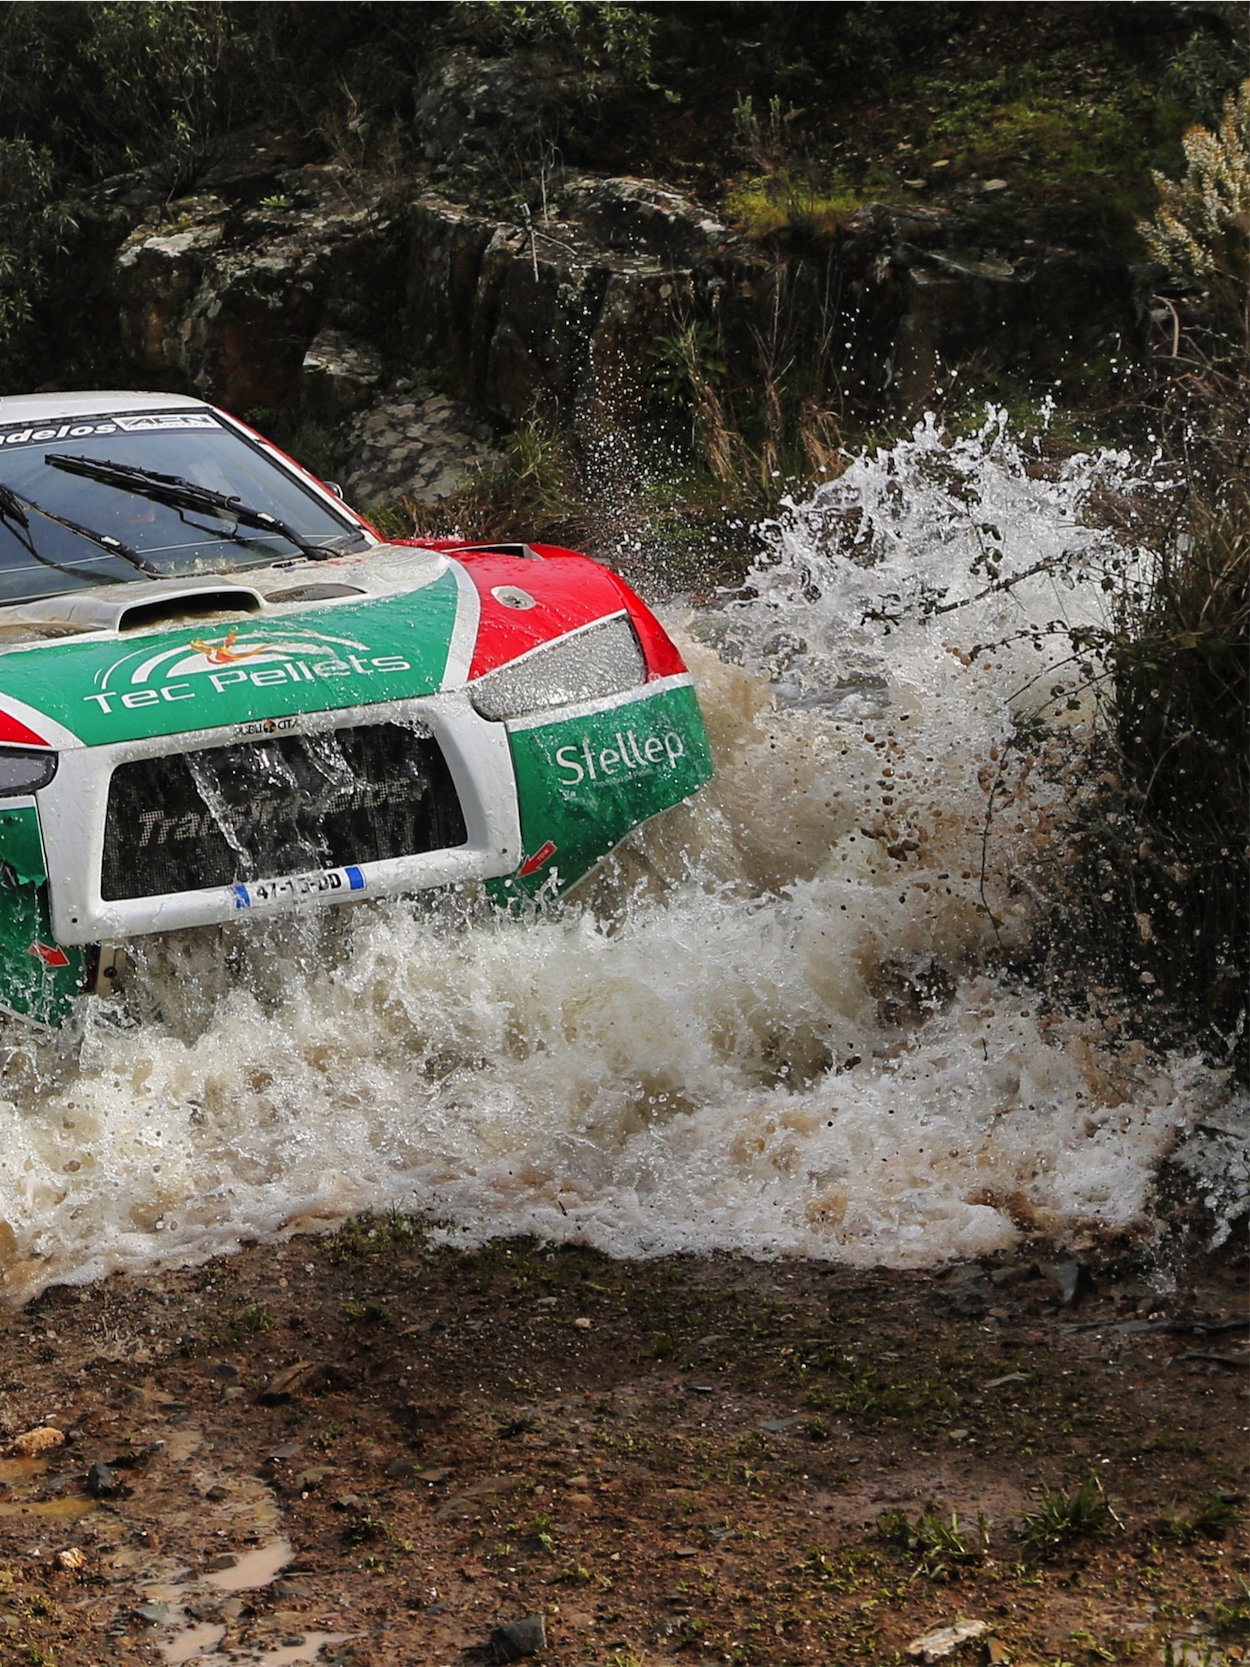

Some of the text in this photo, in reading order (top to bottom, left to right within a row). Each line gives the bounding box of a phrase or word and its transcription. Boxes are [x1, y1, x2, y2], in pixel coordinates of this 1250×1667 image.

[83, 653, 412, 714] Tec Pellets
[556, 730, 685, 786] Stellep
